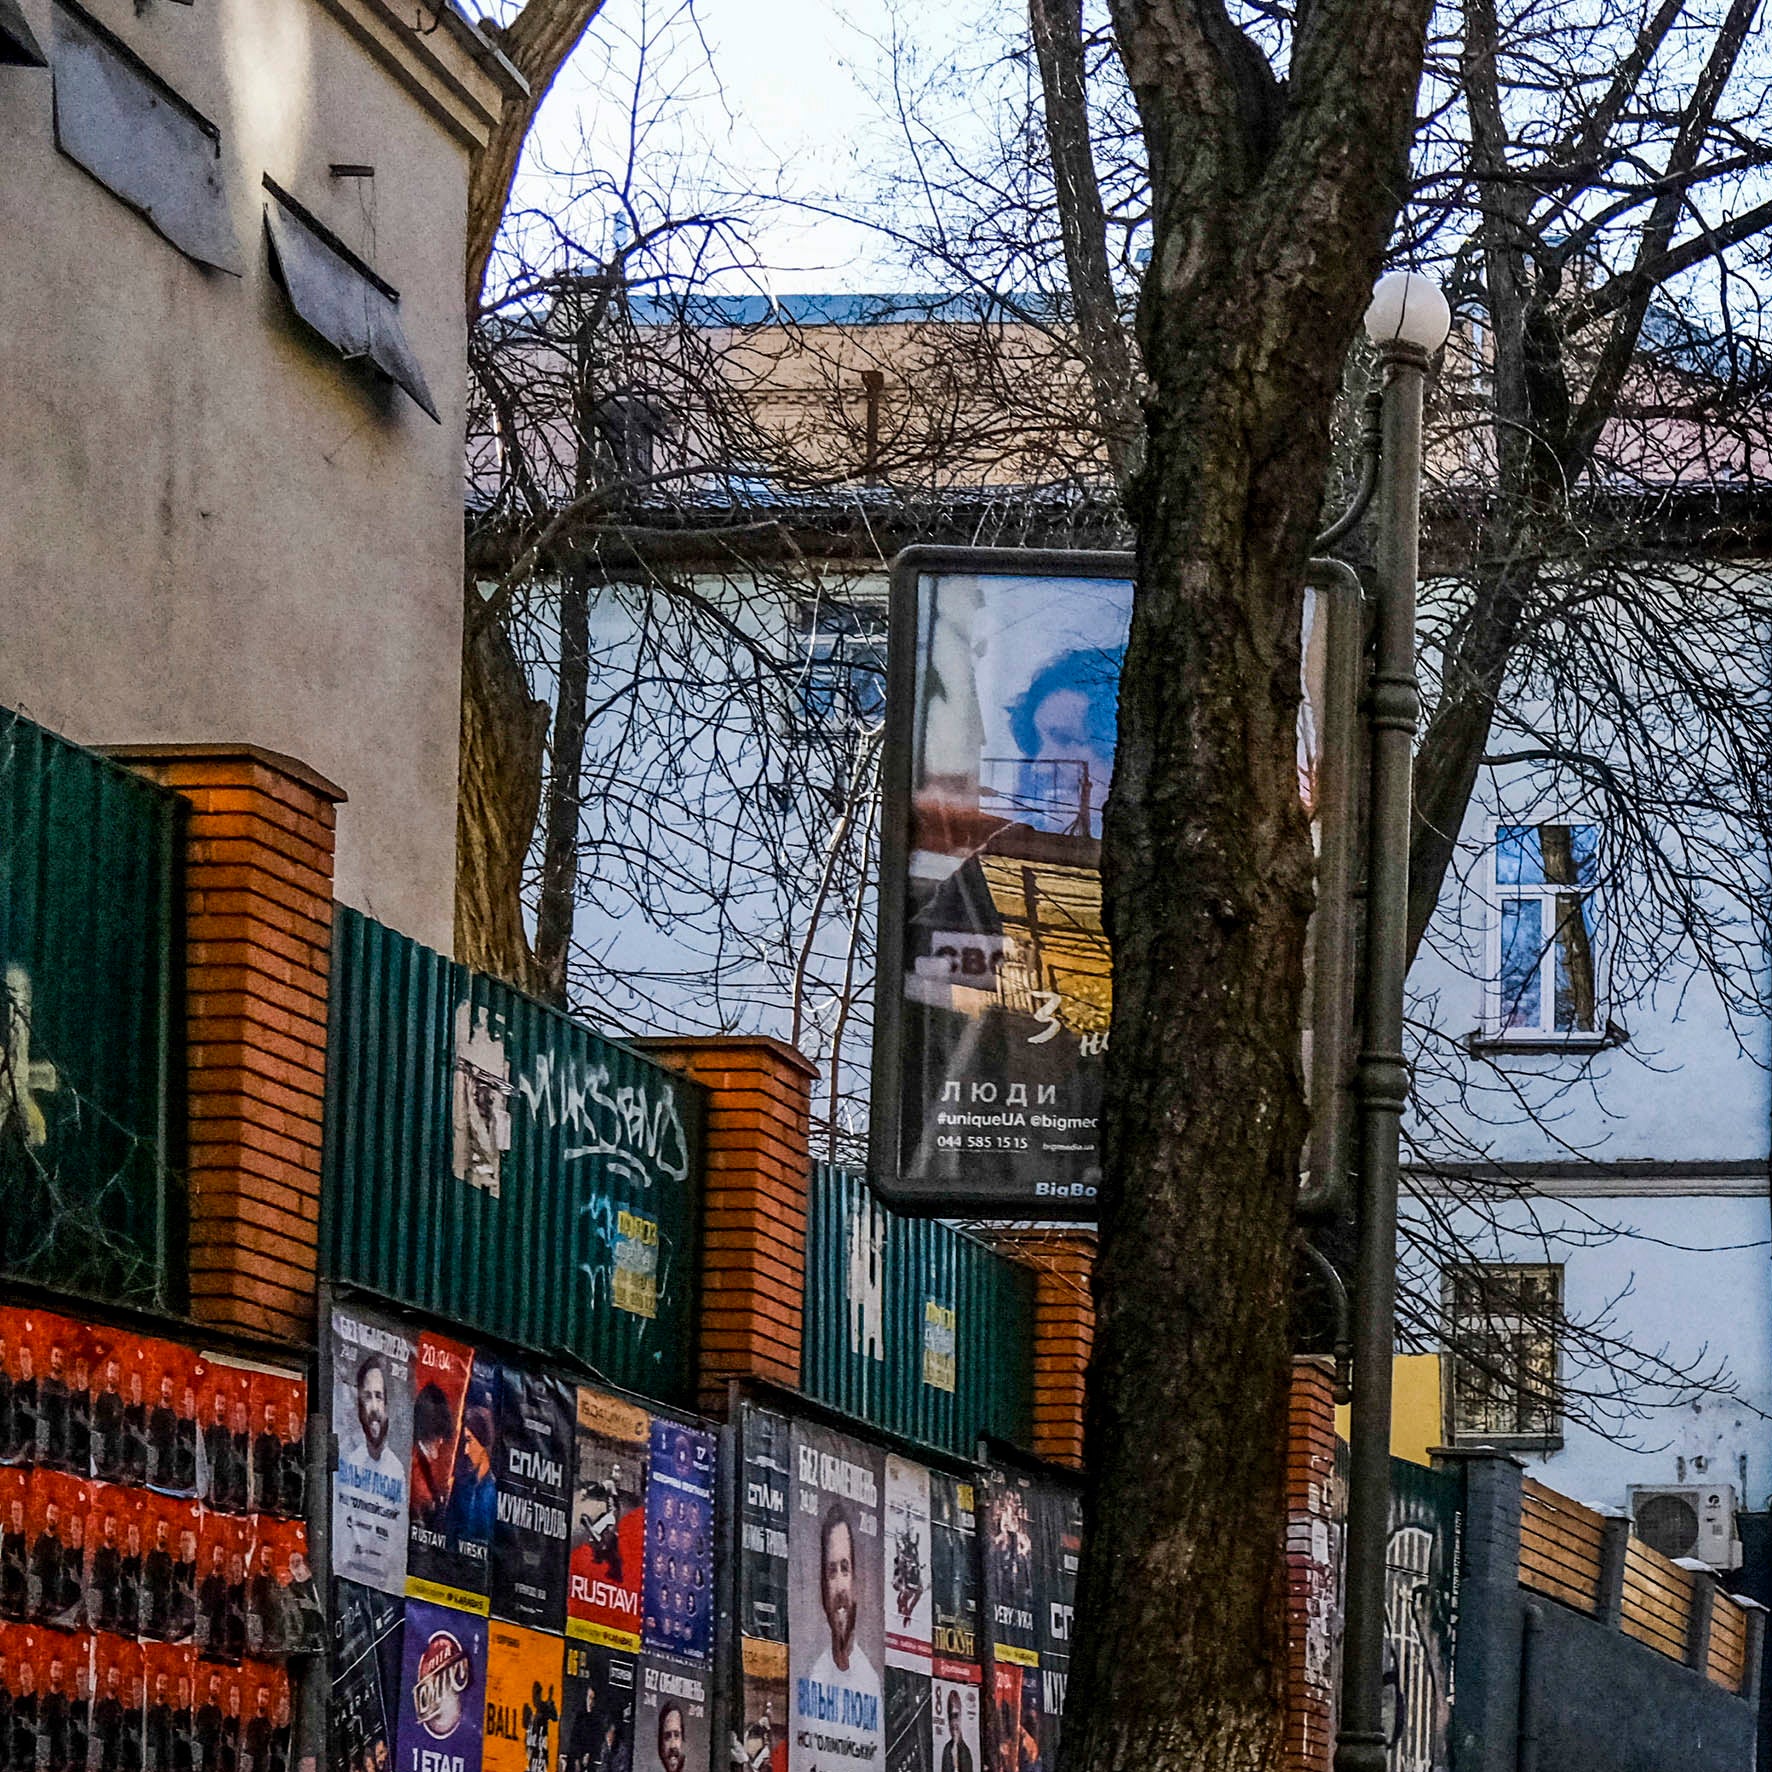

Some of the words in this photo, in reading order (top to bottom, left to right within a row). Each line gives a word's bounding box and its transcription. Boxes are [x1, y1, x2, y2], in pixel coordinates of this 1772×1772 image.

[941, 1081, 1056, 1107] ЛЮДИ
[937, 1112, 1026, 1129] #uniqueUA
[937, 1136, 961, 1148] 044
[967, 1136, 992, 1148] 585
[1035, 1182, 1098, 1197] BigBo
[411, 1525, 447, 1549] RUSTAVI
[458, 1540, 489, 1561] VIRSKY
[572, 1575, 639, 1616] RUSTAVI
